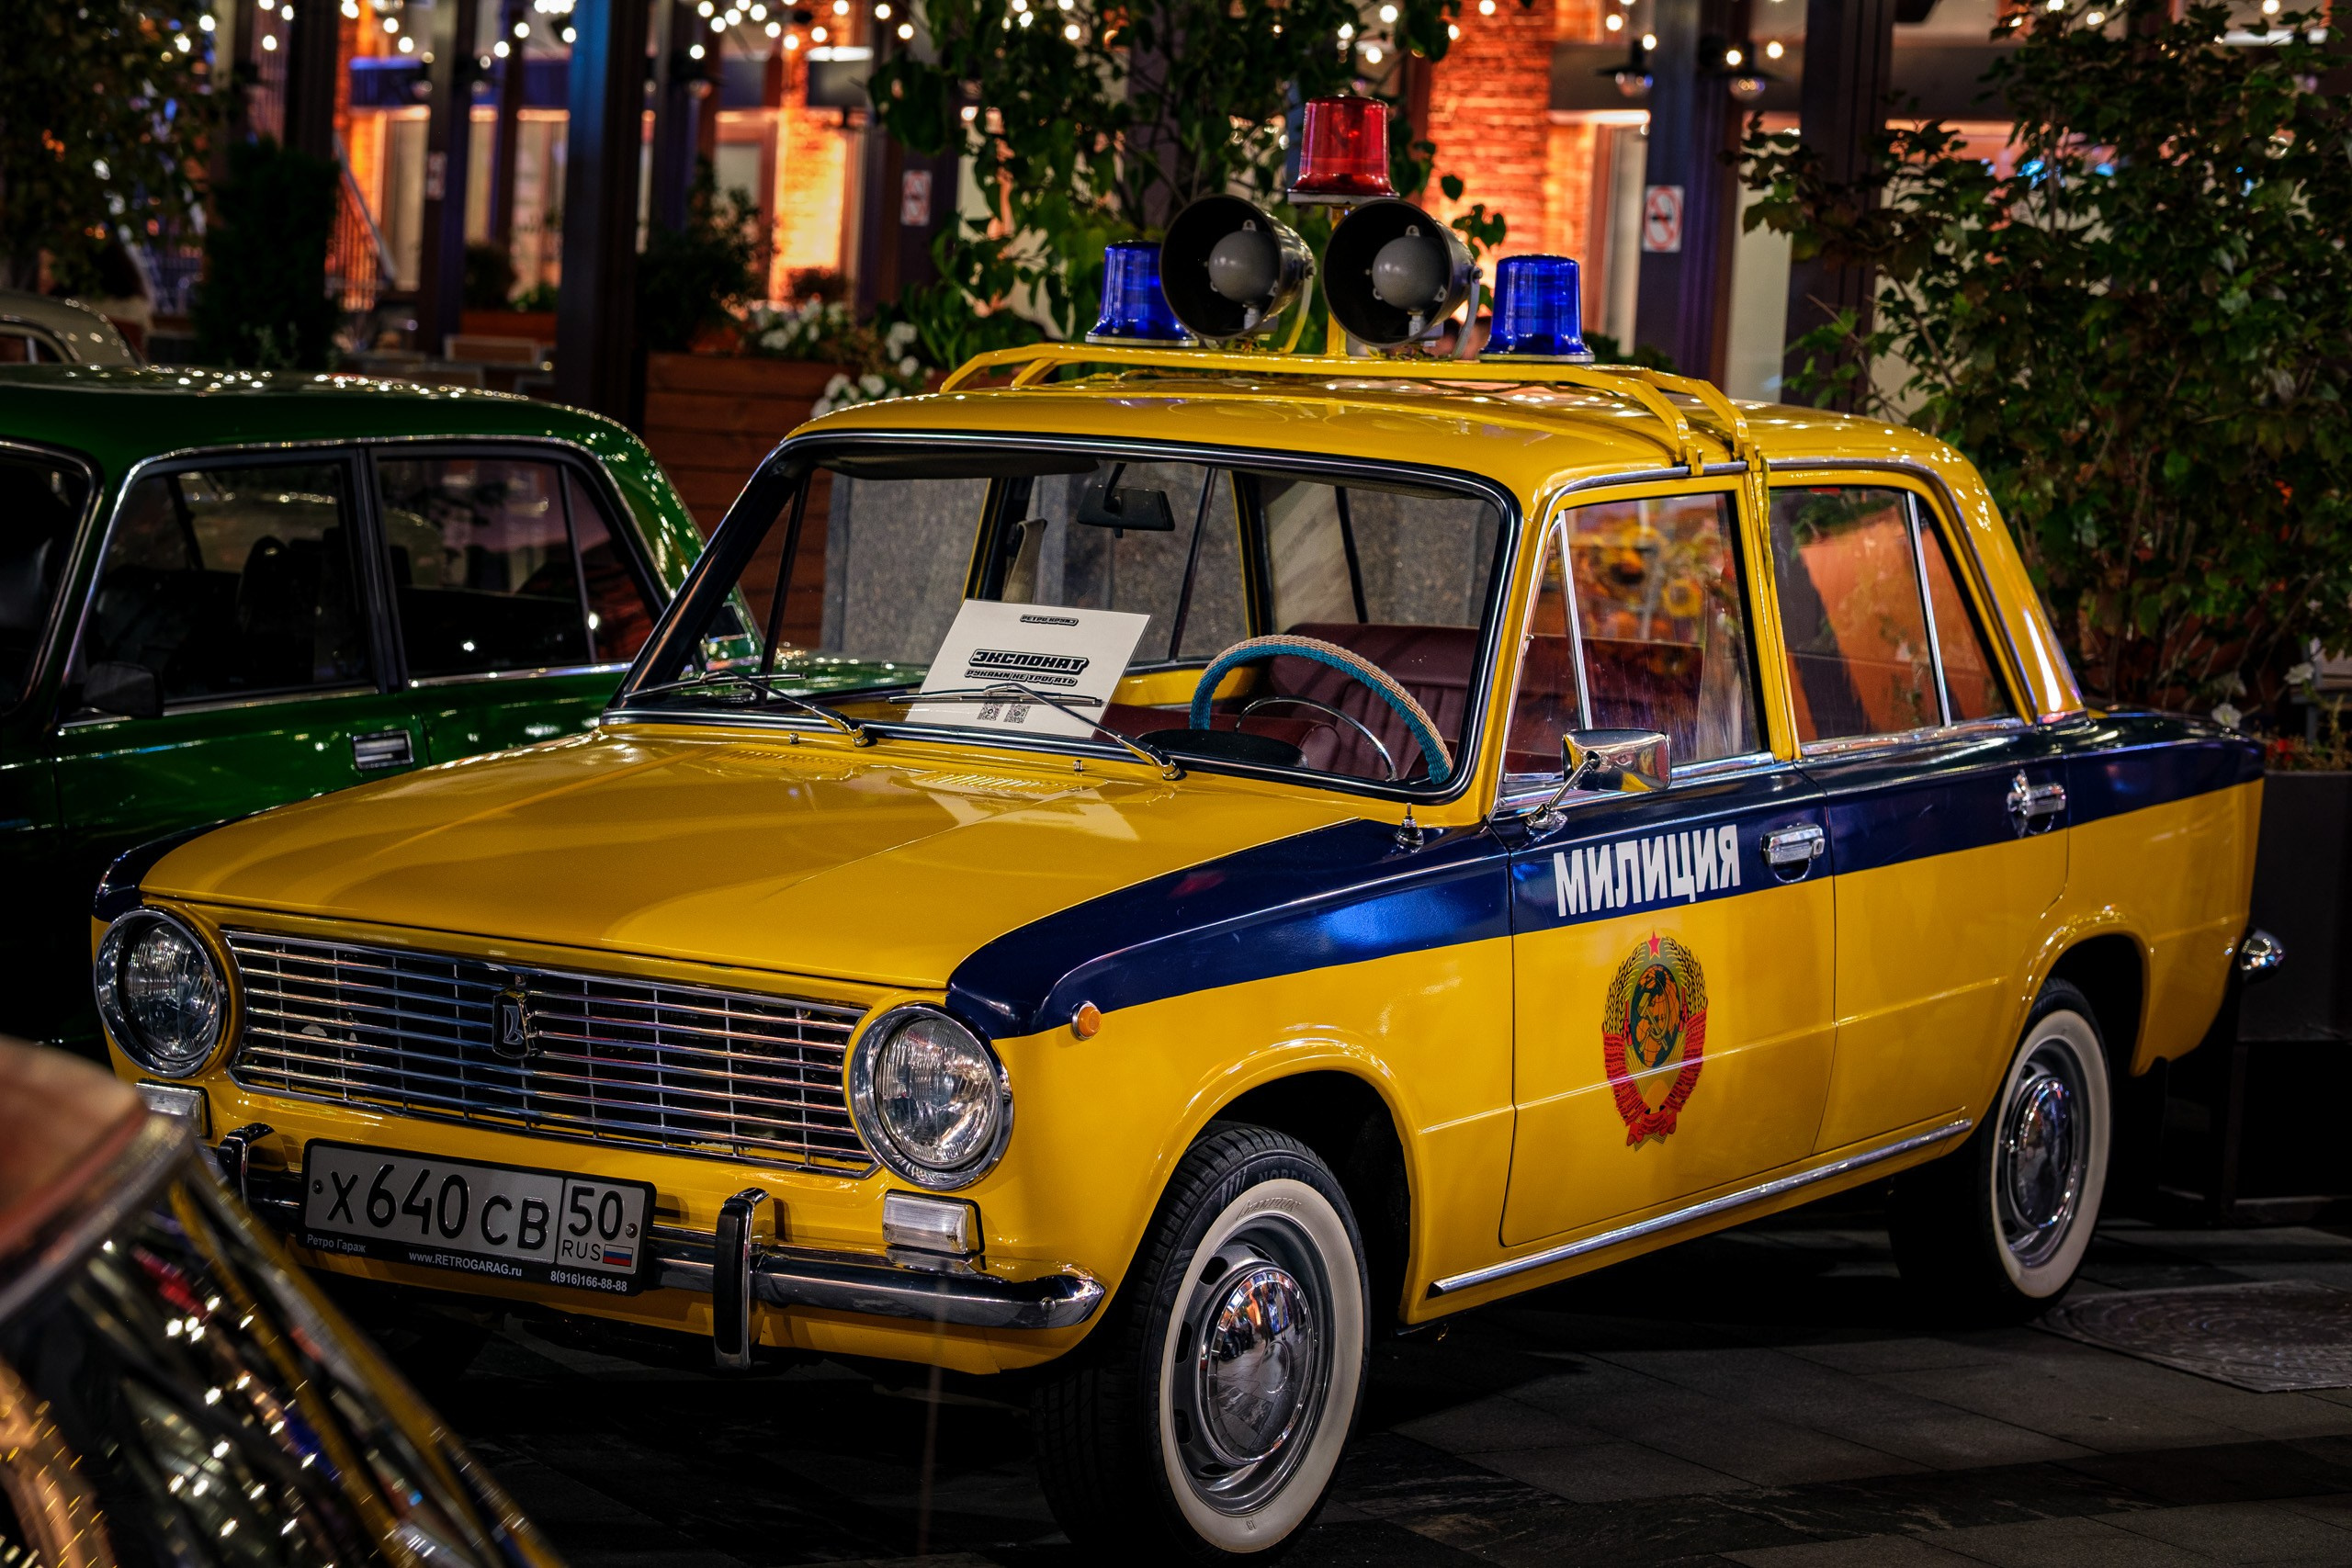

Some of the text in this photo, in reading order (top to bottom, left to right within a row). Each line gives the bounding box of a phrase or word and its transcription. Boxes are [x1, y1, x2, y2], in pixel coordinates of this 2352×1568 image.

[1021, 615, 1047, 623] РЕТРО
[971, 649, 1087, 671] ЭКСПОНАТ
[966, 670, 1076, 684] РУКАМИ НЕ ТРОГАТЬ
[1554, 824, 1741, 917] МИЛИЦИЯ
[568, 1185, 624, 1241] 50
[307, 1234, 367, 1253] Ретро Гараж
[561, 1239, 602, 1262] RUS
[409, 1250, 522, 1278] www.RETROGARAG.ru
[550, 1269, 628, 1292] 8(916)166-88-88
